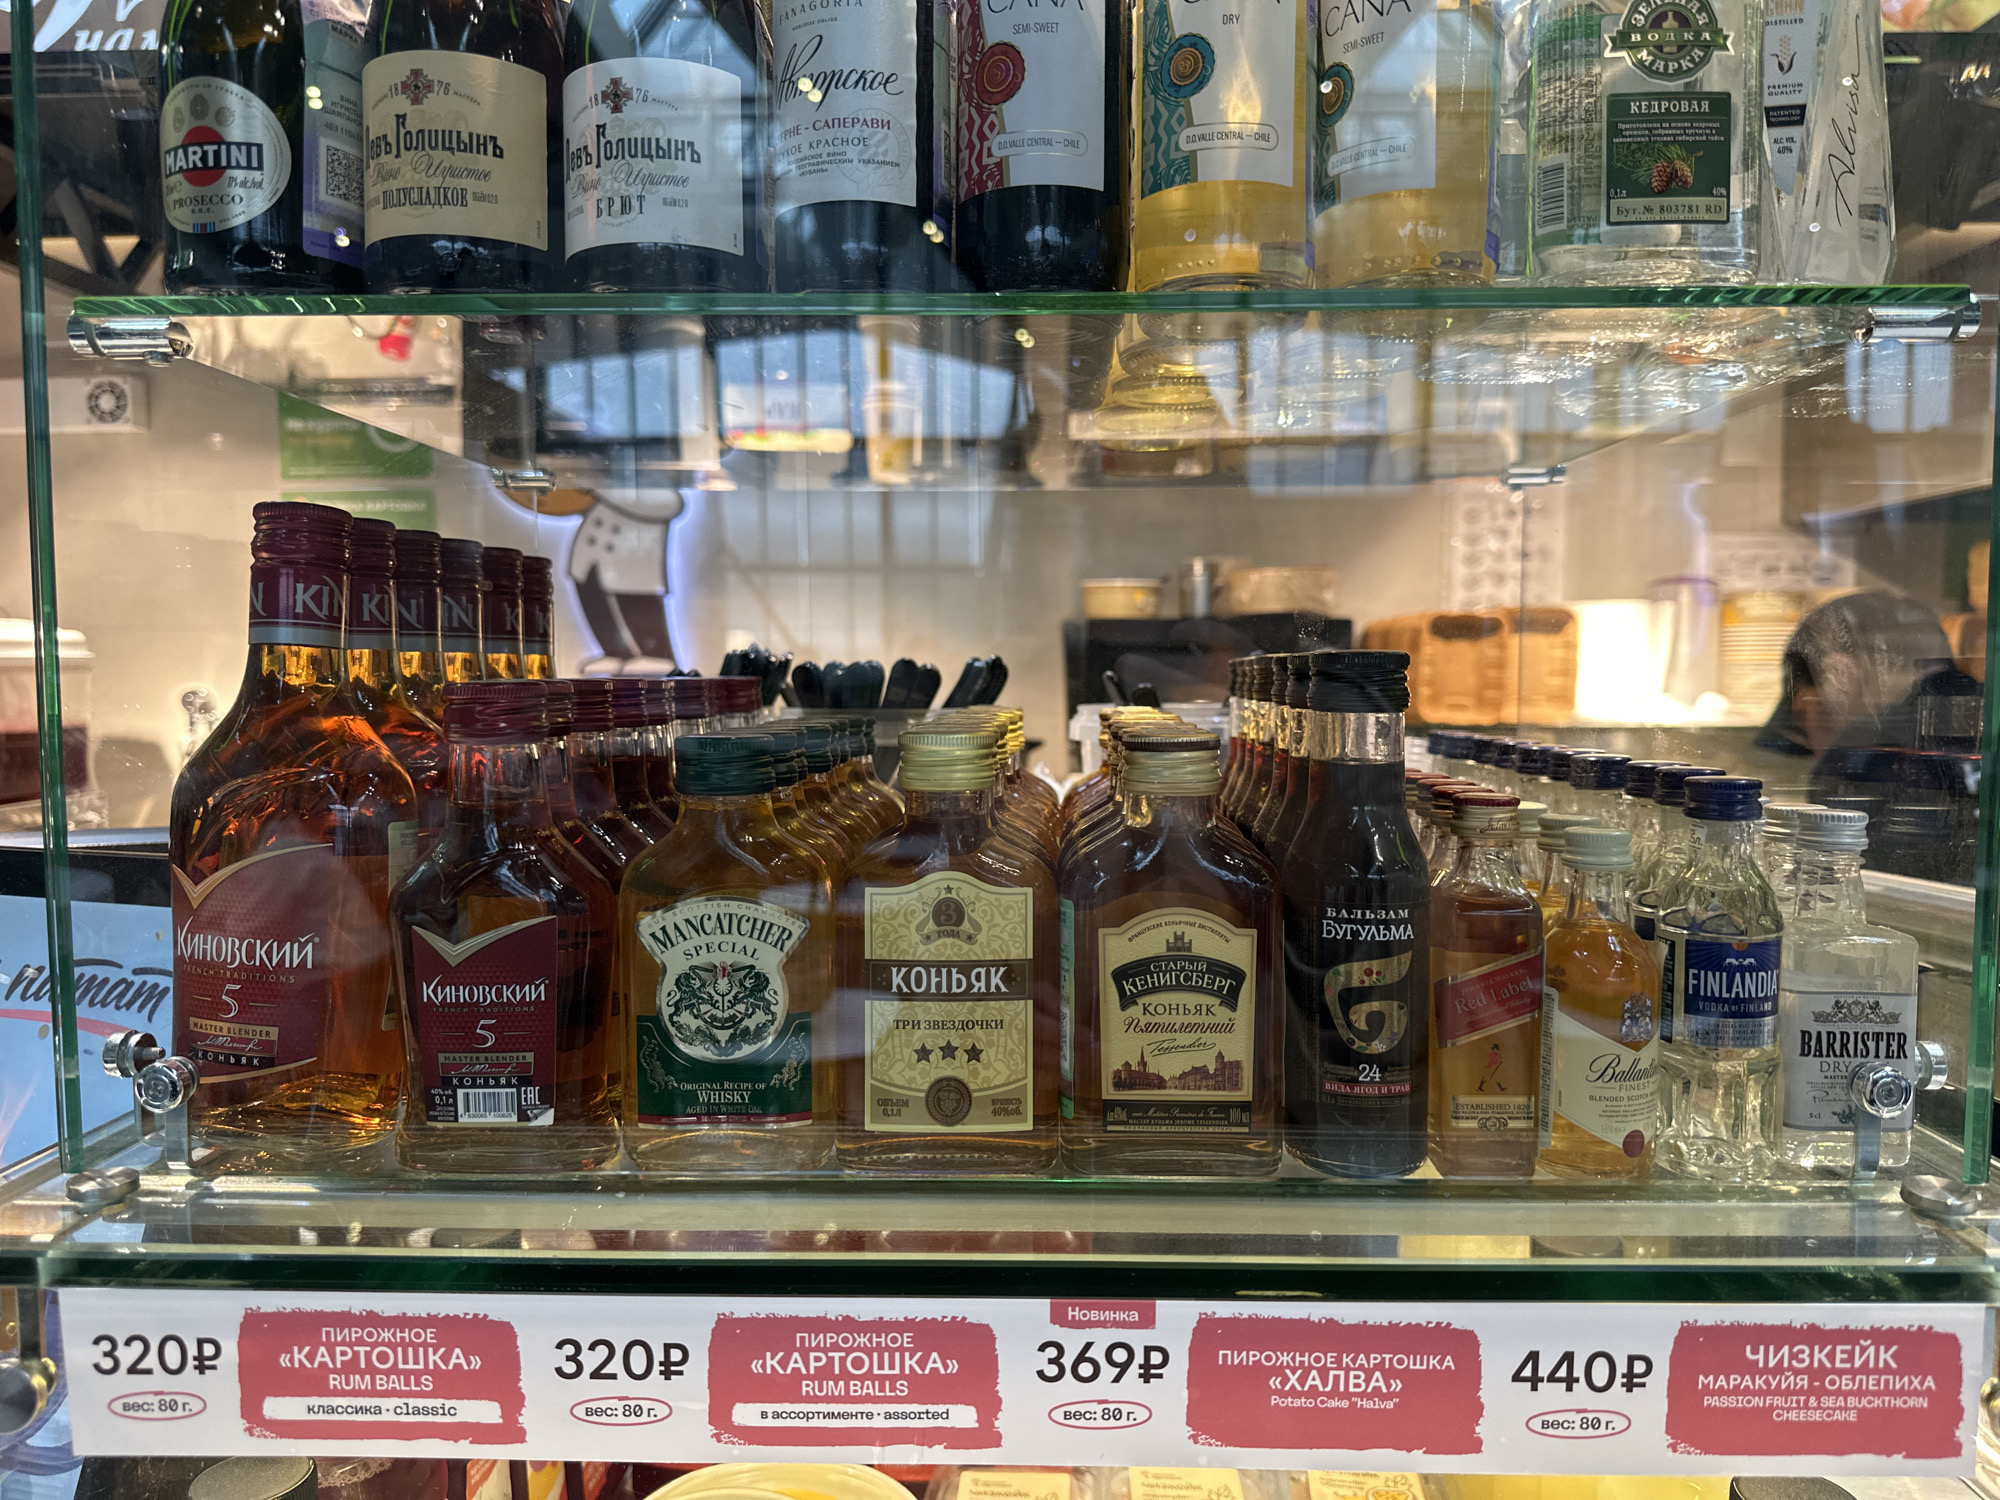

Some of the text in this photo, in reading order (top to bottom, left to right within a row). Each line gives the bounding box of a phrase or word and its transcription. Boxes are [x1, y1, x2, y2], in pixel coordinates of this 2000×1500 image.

[779, 0, 863, 25] FANAGORIA
[1222, 14, 1240, 25] DRY
[1012, 22, 1059, 35] SEMI-SWEET
[1765, 18, 1804, 27] DISTILLED
[1343, 32, 1385, 54] SEMI-SWEET
[1631, 32, 1711, 42] ВОДКА
[1637, 48, 1705, 74] МАРКА
[775, 34, 904, 112] Авторское
[1630, 101, 1710, 114] КЕДРОВАЯ
[812, 117, 891, 131] САПЕРАВИ
[394, 113, 504, 160] Голицынъ
[809, 137, 869, 150] КРАСНОЕ
[1026, 138, 1080, 149] CENTRAL CHILE
[1216, 131, 1244, 141] CENTRAL
[1254, 132, 1271, 143] CHILE
[596, 123, 701, 168] Голицынъ
[1388, 144, 1407, 154] CHILE
[165, 143, 259, 176] MARTINI
[857, 158, 900, 168] УКАЗАНИЕМ
[1712, 187, 1727, 197] 40%
[173, 194, 243, 210] PROSECCO
[596, 195, 646, 218] БРЮТ
[1659, 205, 1722, 215] 803781 RD
[673, 903, 804, 930] SCOTTISH CHARACTER
[940, 902, 957, 924] 3
[1326, 907, 1410, 919] БАЛЬЗАМ
[1164, 920, 1197, 928] КОНЬЯЧНЫЕ
[649, 911, 794, 955] MANCATCHER
[936, 928, 961, 940] ГОДА
[683, 941, 760, 961] SPECIAL
[1150, 960, 1207, 972] СТАРЫЙ
[183, 964, 296, 984] FRENCH TRADITIONS
[890, 966, 1009, 993] КОНЬЯК
[1122, 971, 1236, 996] КЕНИГСБЕРГ
[1688, 968, 1777, 999] FINLANDIA
[217, 984, 242, 1018] 5
[1455, 992, 1488, 1014] Red
[1490, 976, 1534, 1002] Label
[474, 1005, 535, 1013] TRADITIONS
[1699, 1001, 1772, 1012] VODKA FINLAND
[193, 1021, 272, 1039] MASTER BLENDER
[893, 1018, 1004, 1033] ТРИ ЗВЕЗДОЧКИ
[1123, 1016, 1237, 1034] Пятилетний
[472, 1019, 498, 1048] 5
[1799, 1030, 1908, 1059] BARRISTER
[198, 1050, 260, 1066] КОНЬЯК
[444, 1054, 528, 1063] MASTER BLENDER
[1358, 1064, 1382, 1081] 24
[1820, 1061, 1852, 1073] DRY
[453, 1076, 518, 1086] КОНЬЯК
[1325, 1082, 1410, 1095] ВИДА ЯГОД И ТРАВ
[1618, 1081, 1651, 1092] FINEST
[877, 1098, 908, 1107] ОБЪЕМ
[1589, 1094, 1625, 1102] BLENDED
[686, 1104, 707, 1114] AGED
[1513, 1103, 1531, 1111] 1820
[1067, 1306, 1139, 1321] Новинка
[321, 1327, 437, 1343] ПИРОЖНОЕ
[796, 1332, 914, 1348] ПИРОЖНОЕ
[92, 1333, 222, 1375] 320₽
[279, 1345, 482, 1371] «КАРТОШКА»
[554, 1338, 690, 1380] 320₽
[1218, 1350, 1455, 1370] ПИРОЖНОЕ КАРТОШКА
[1745, 1340, 1898, 1368] ЧИЗКЕЙК
[750, 1351, 959, 1375] «КАРТОШКА»
[1036, 1340, 1170, 1384] 369₽
[1511, 1350, 1653, 1393] 440₽
[329, 1374, 433, 1391] RUM BALLS
[802, 1380, 908, 1396] RUM BALLS
[1268, 1369, 1403, 1393] «ХАЛВА»
[1698, 1371, 1936, 1390] МАРАКУЙЯ ОБЛЕПИХА
[122, 1399, 193, 1412] вес: 80 г.
[307, 1402, 457, 1416] классика classic
[1270, 1395, 1314, 1408] Potato
[1317, 1396, 1349, 1408] Cake
[1703, 1395, 1928, 1408] PASSION FRUIT & SEA BUCKTHORN
[585, 1404, 658, 1417] вес: 80 г.
[760, 1408, 949, 1422] в ассортименте assorted
[1063, 1407, 1138, 1421] вес: 80 г.
[1773, 1409, 1858, 1421] CHEESECAKE
[1541, 1416, 1616, 1430] вес: 80 г.
